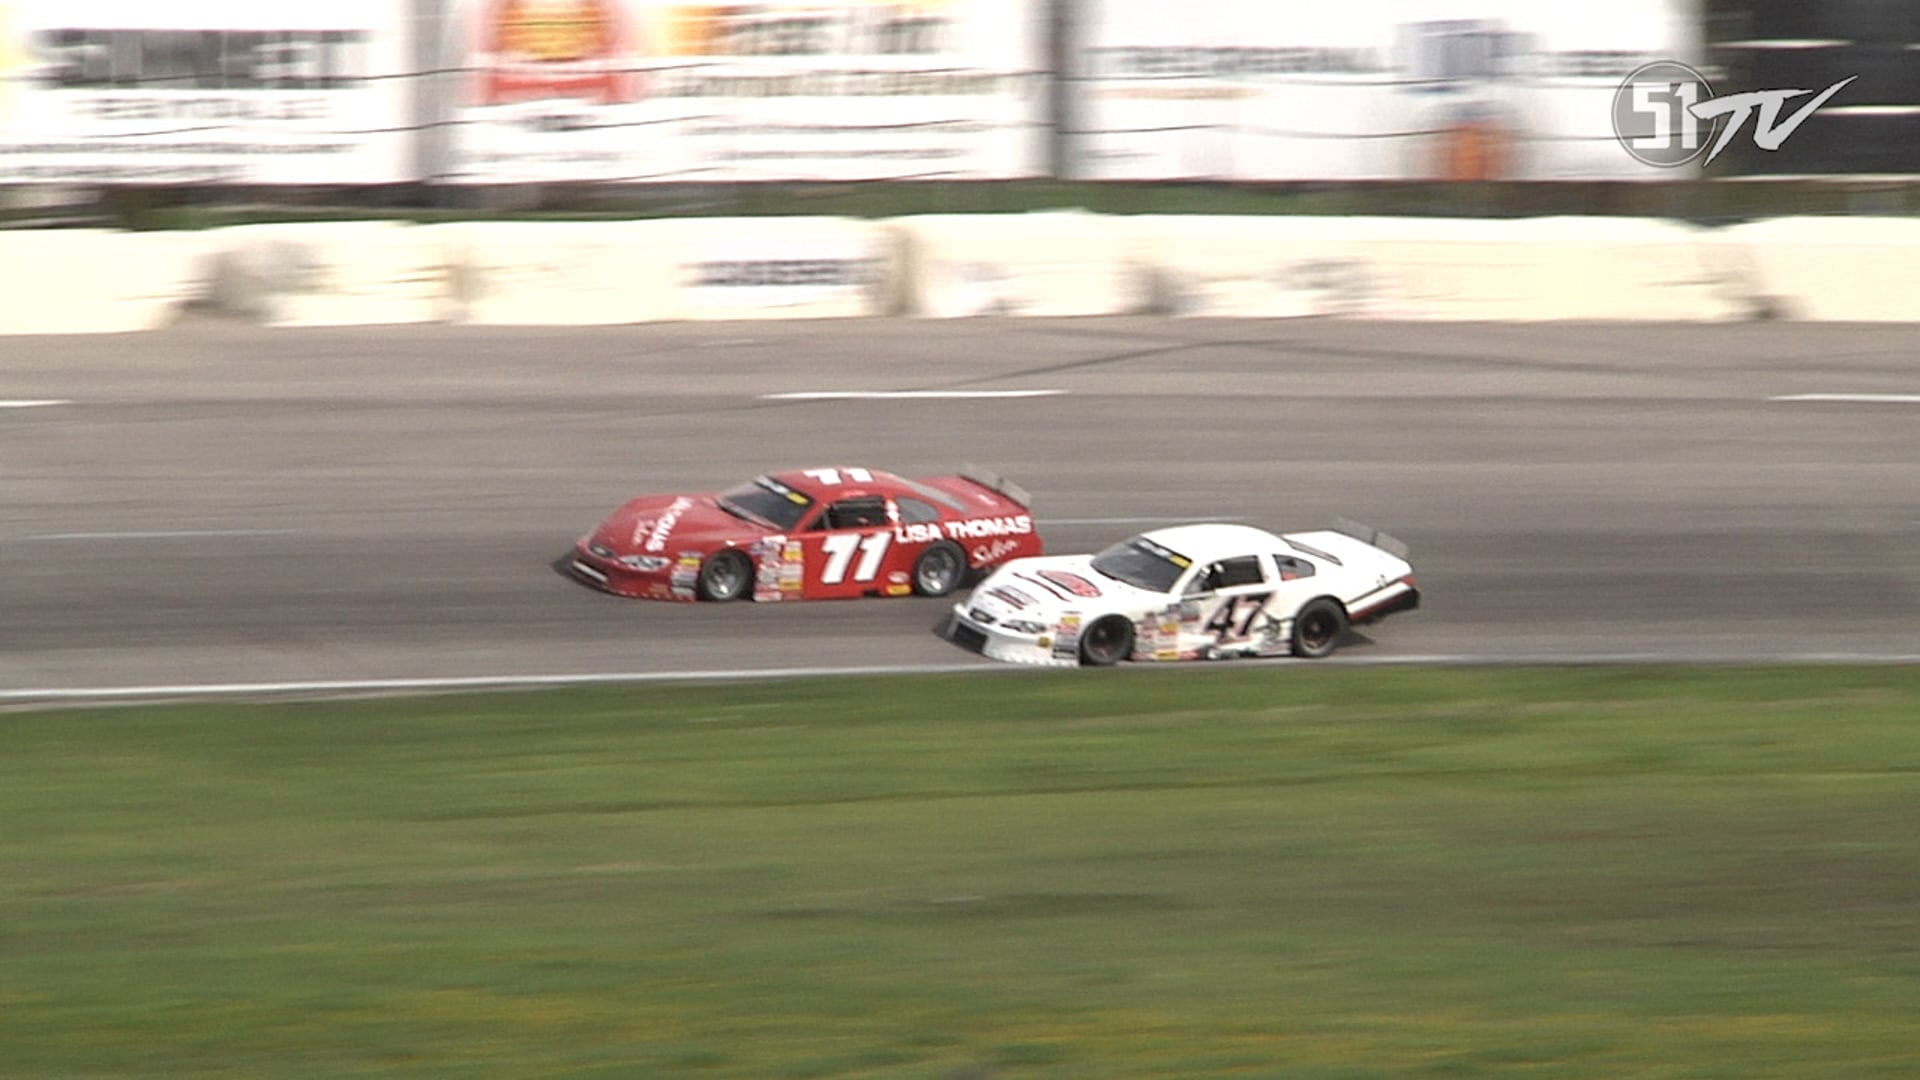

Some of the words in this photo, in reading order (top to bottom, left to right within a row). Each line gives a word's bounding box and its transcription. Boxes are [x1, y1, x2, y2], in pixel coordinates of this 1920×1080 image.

[802, 468, 873, 485] 71
[895, 523, 943, 544] LISA
[944, 515, 1032, 539] THOMAS
[821, 531, 894, 585] 71
[1204, 591, 1275, 644] 47
